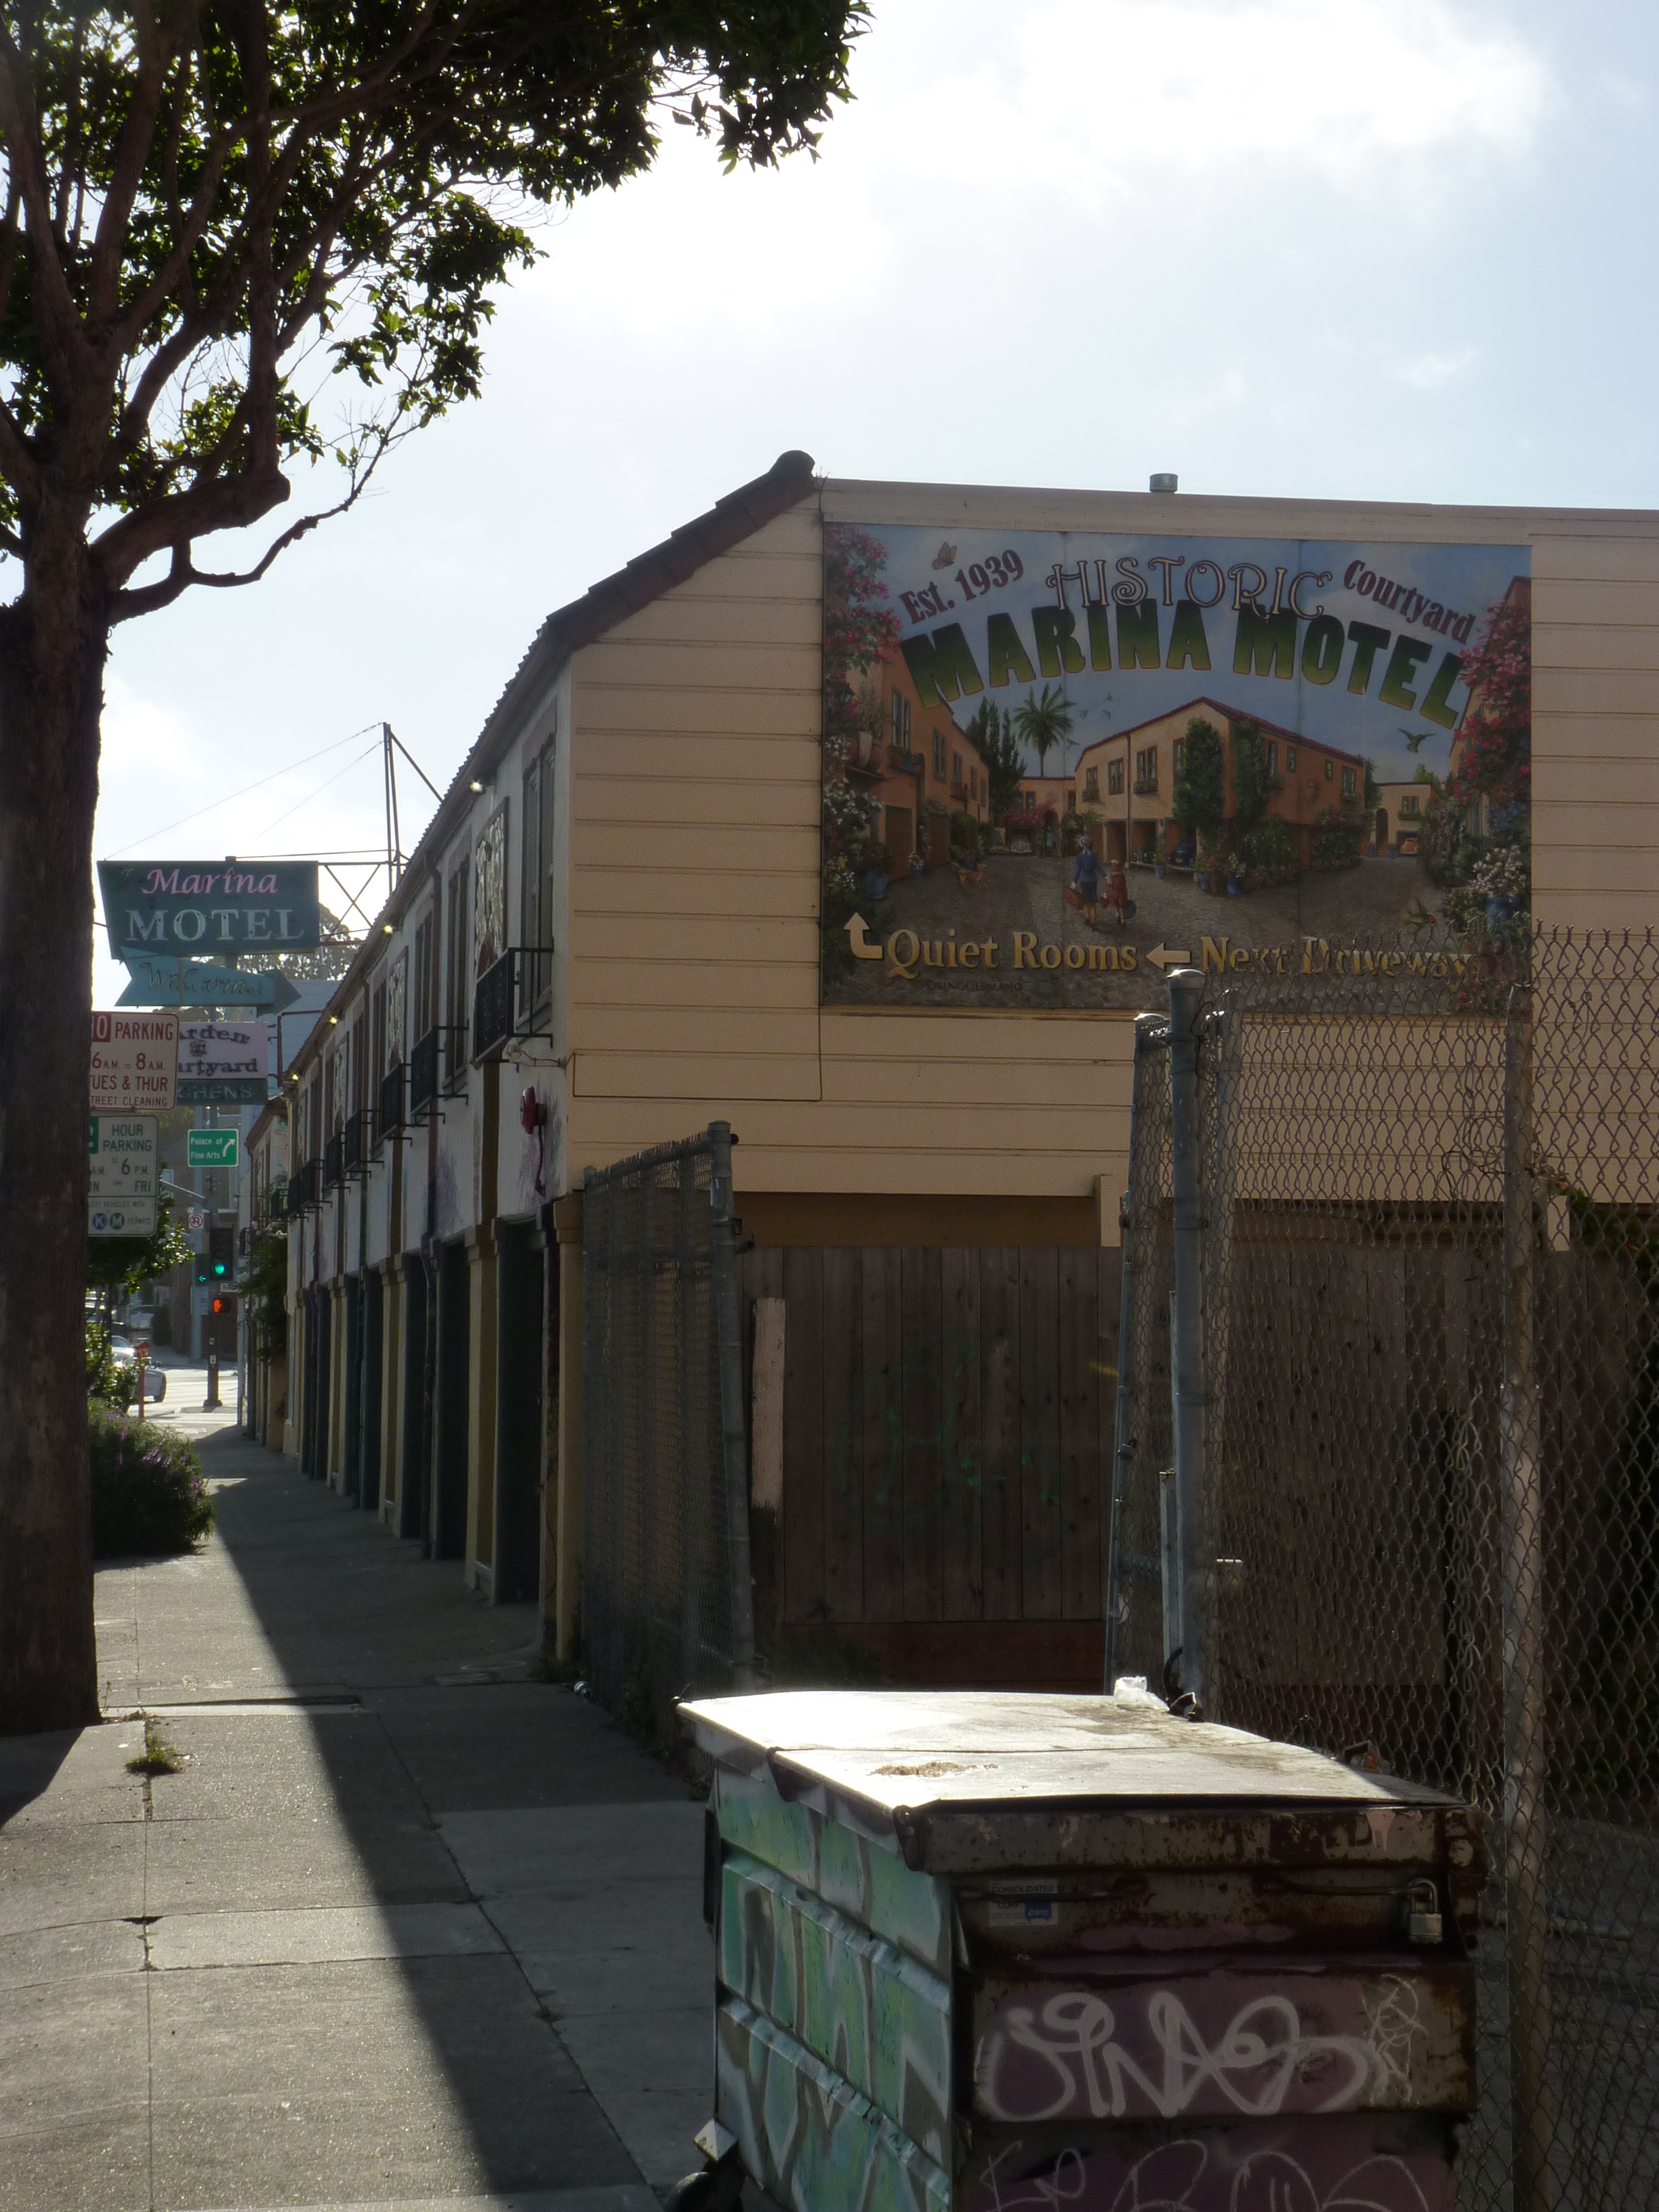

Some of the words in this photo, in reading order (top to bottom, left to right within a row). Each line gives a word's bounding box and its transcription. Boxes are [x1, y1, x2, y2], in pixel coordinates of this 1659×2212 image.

[899, 581, 956, 624] Est.
[955, 550, 1024, 601] 1939
[1046, 556, 1332, 619] HISTORIC
[1343, 559, 1477, 644] Courtyard
[900, 599, 1211, 710] MARINA
[1233, 602, 1464, 729] MOTEL
[140, 867, 279, 895] Marina
[125, 908, 305, 941] MOTEL
[886, 928, 1000, 980] Quiet
[1012, 930, 1138, 971] Rooms
[1200, 936, 1286, 975] Next
[1300, 936, 1469, 992] Driveway
[139, 961, 262, 996] Welcome
[115, 1022, 173, 1040] PARKING
[92, 1052, 102, 1069] 6
[136, 1052, 146, 1070] 8
[122, 1076, 130, 1090] &
[136, 1076, 168, 1092] THUR
[177, 1085, 253, 1099] CHENS
[91, 1095, 118, 1105] TREET
[123, 1097, 167, 1107] CLEANING
[112, 1124, 143, 1136] HOUR
[102, 1139, 152, 1151] PARKING
[121, 1158, 130, 1175] 6
[135, 1181, 151, 1193] FRI
[112, 1214, 123, 1228] M
[991, 1885, 1054, 1893] CONSOLIDATED
